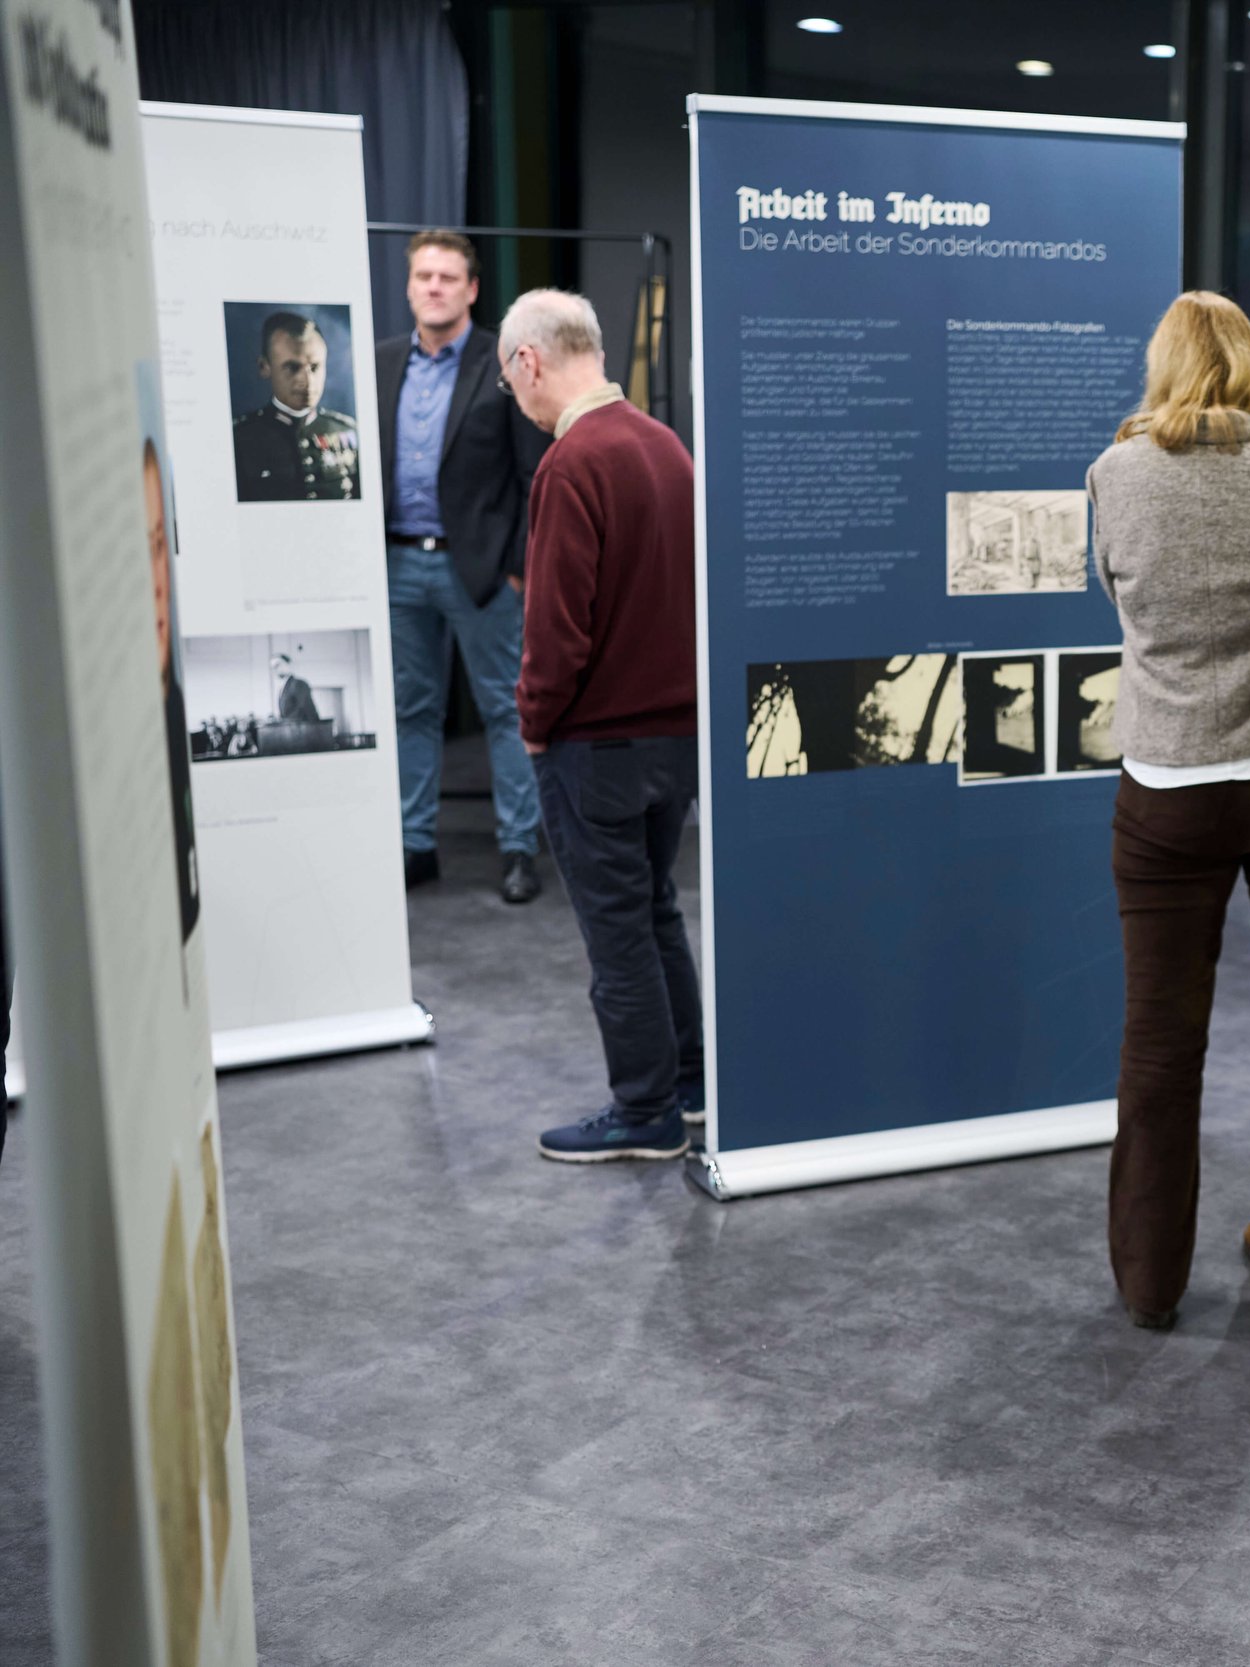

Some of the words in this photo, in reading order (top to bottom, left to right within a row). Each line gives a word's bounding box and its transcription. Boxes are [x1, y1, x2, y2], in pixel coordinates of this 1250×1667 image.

[736, 185, 828, 224] Arbeit
[837, 190, 876, 223] im
[885, 192, 991, 231] Inferno
[162, 218, 216, 239] nach
[220, 218, 328, 243] Auschwitz
[739, 227, 778, 251] Die
[782, 229, 850, 254] Arbeit
[855, 231, 893, 255] der
[898, 232, 1107, 262] Sonderkommandos
